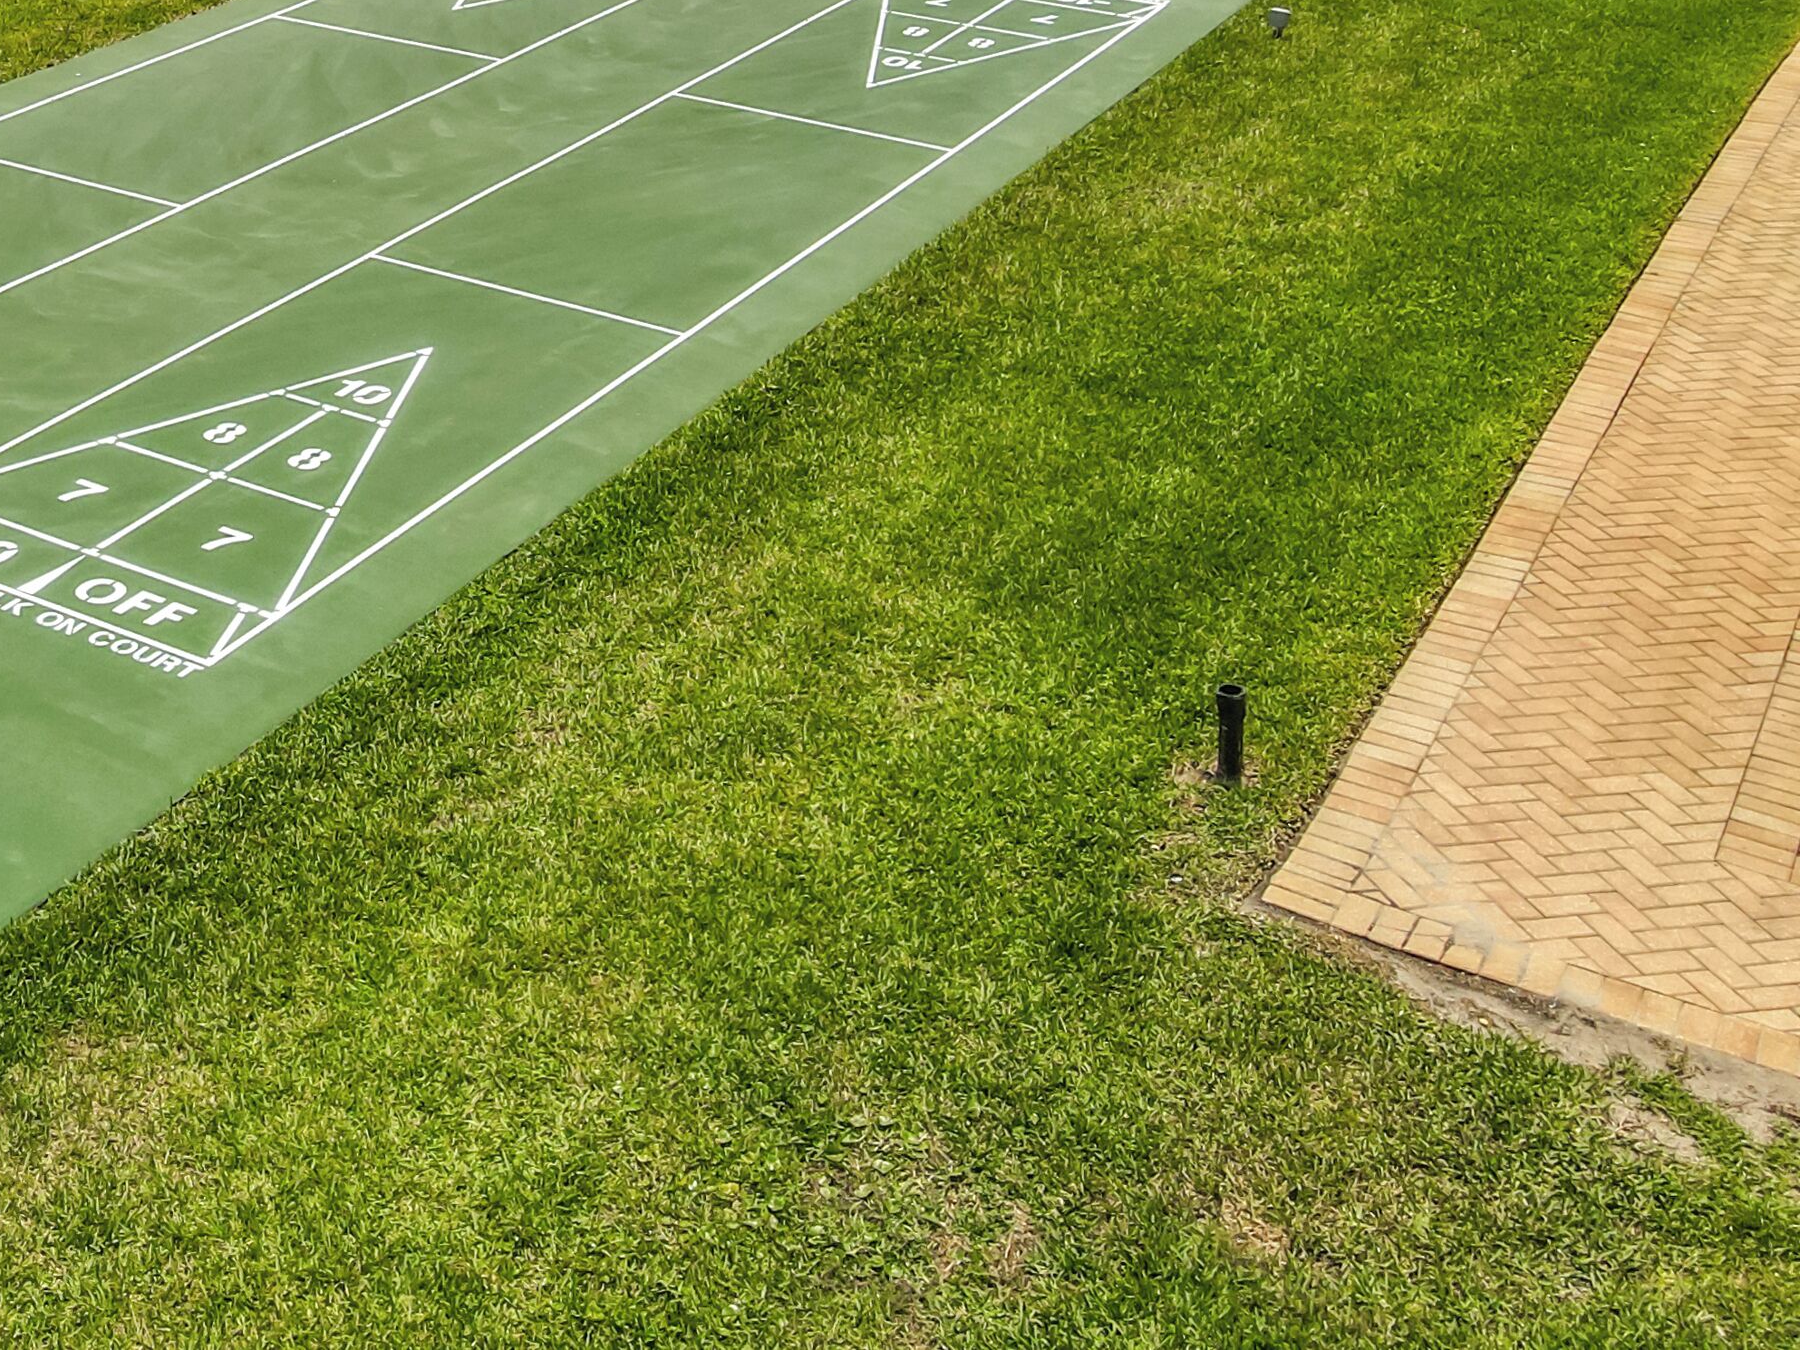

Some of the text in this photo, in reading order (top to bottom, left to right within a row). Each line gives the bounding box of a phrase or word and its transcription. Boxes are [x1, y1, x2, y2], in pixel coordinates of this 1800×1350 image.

[1030, 14, 1059, 25] 7
[902, 26, 930, 37] 8
[967, 37, 995, 49] 8
[881, 55, 922, 70] 10
[334, 379, 392, 405] 10
[202, 422, 248, 444] 8
[287, 448, 332, 470] 8
[57, 478, 110, 502] 7
[200, 525, 254, 551] 7
[74, 577, 198, 626] OFF
[35, 611, 88, 636] ON
[87, 630, 205, 678] COURT
